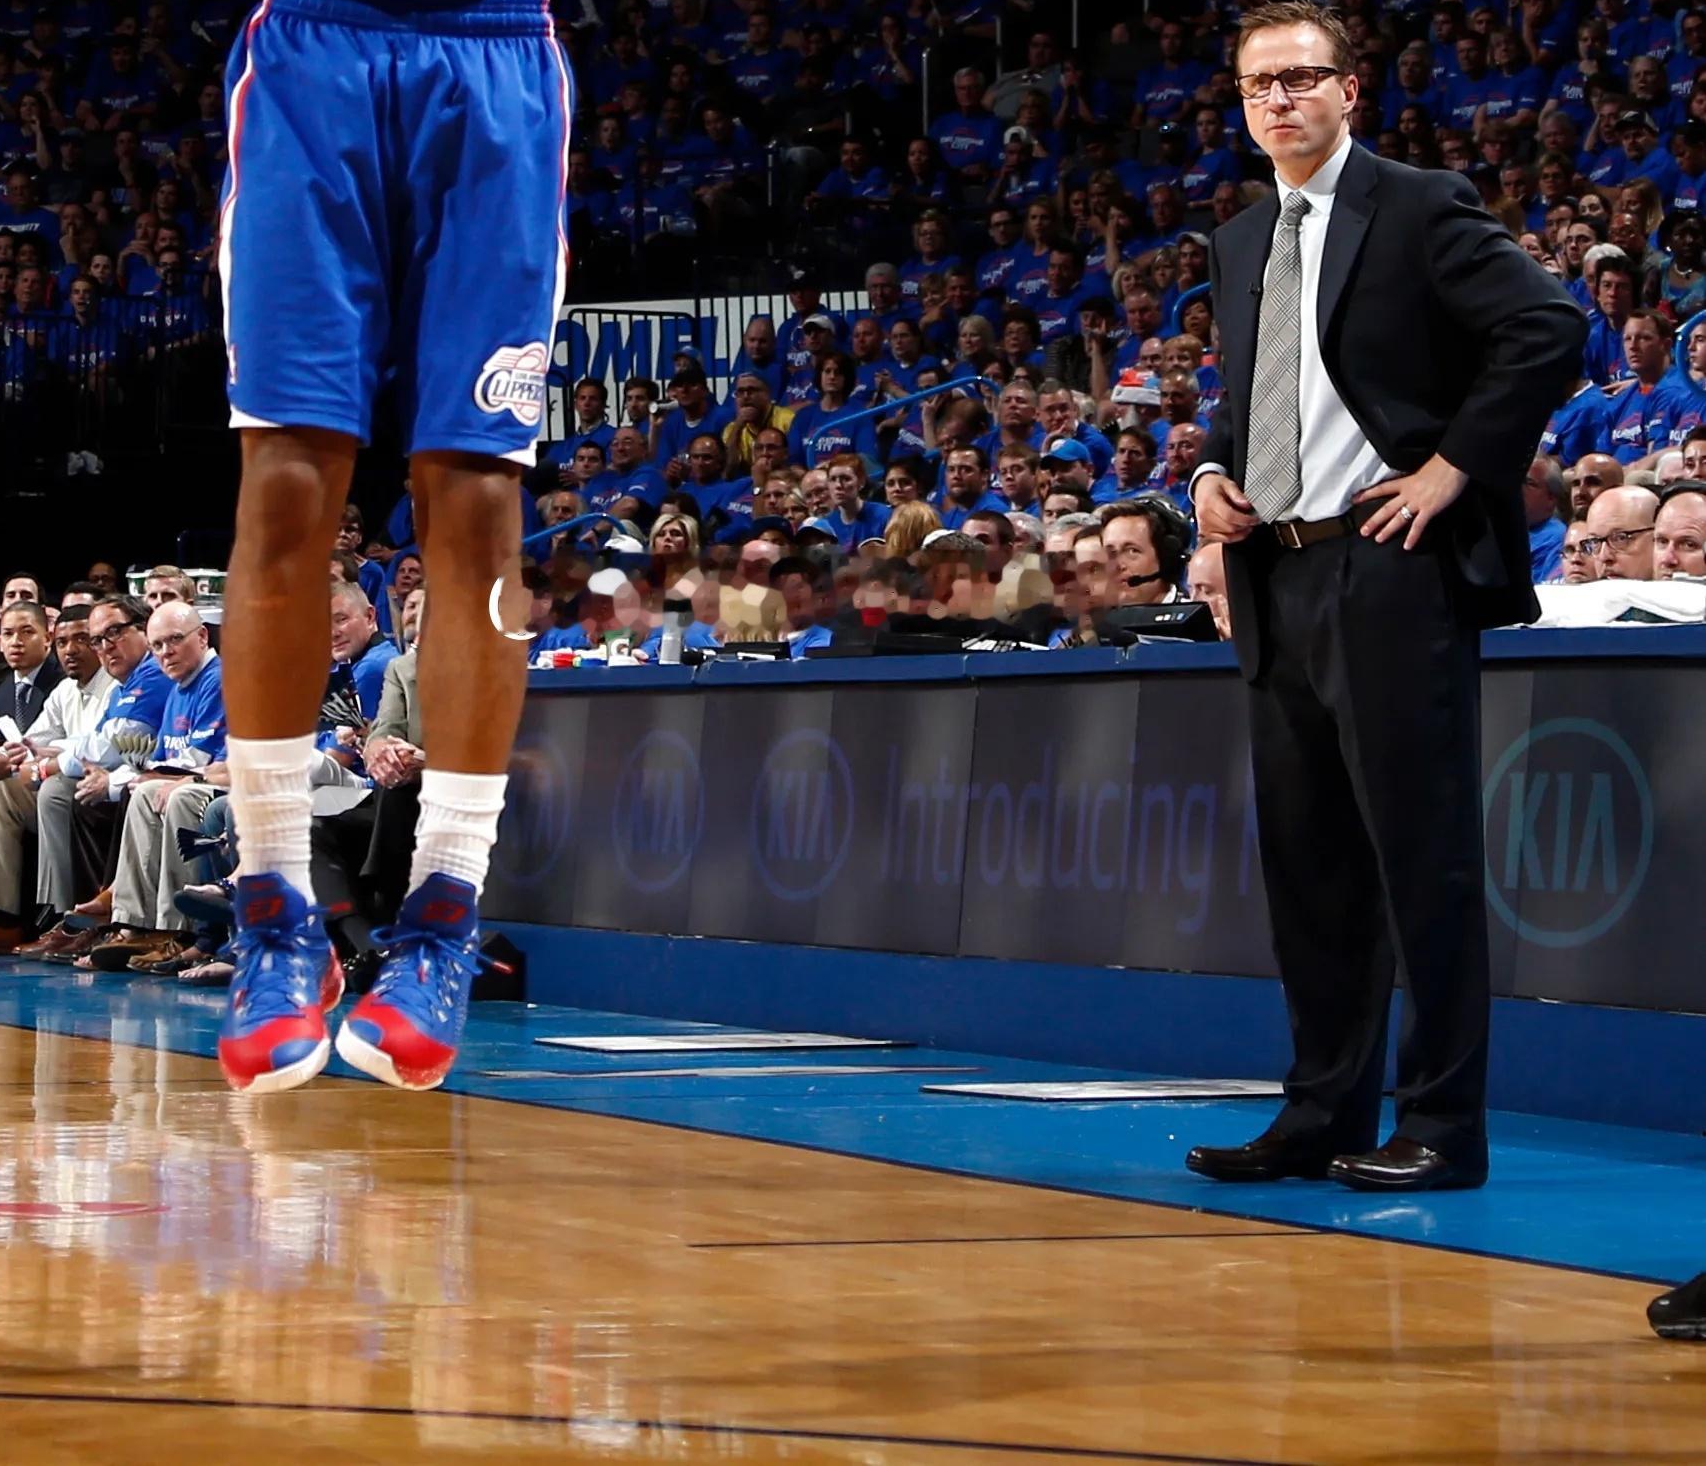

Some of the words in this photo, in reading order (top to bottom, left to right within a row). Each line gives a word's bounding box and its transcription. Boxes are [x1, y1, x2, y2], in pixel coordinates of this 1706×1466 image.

[766, 769, 833, 863] KIA
[880, 743, 1218, 935] Introducing
[1503, 771, 1619, 894] KIA
